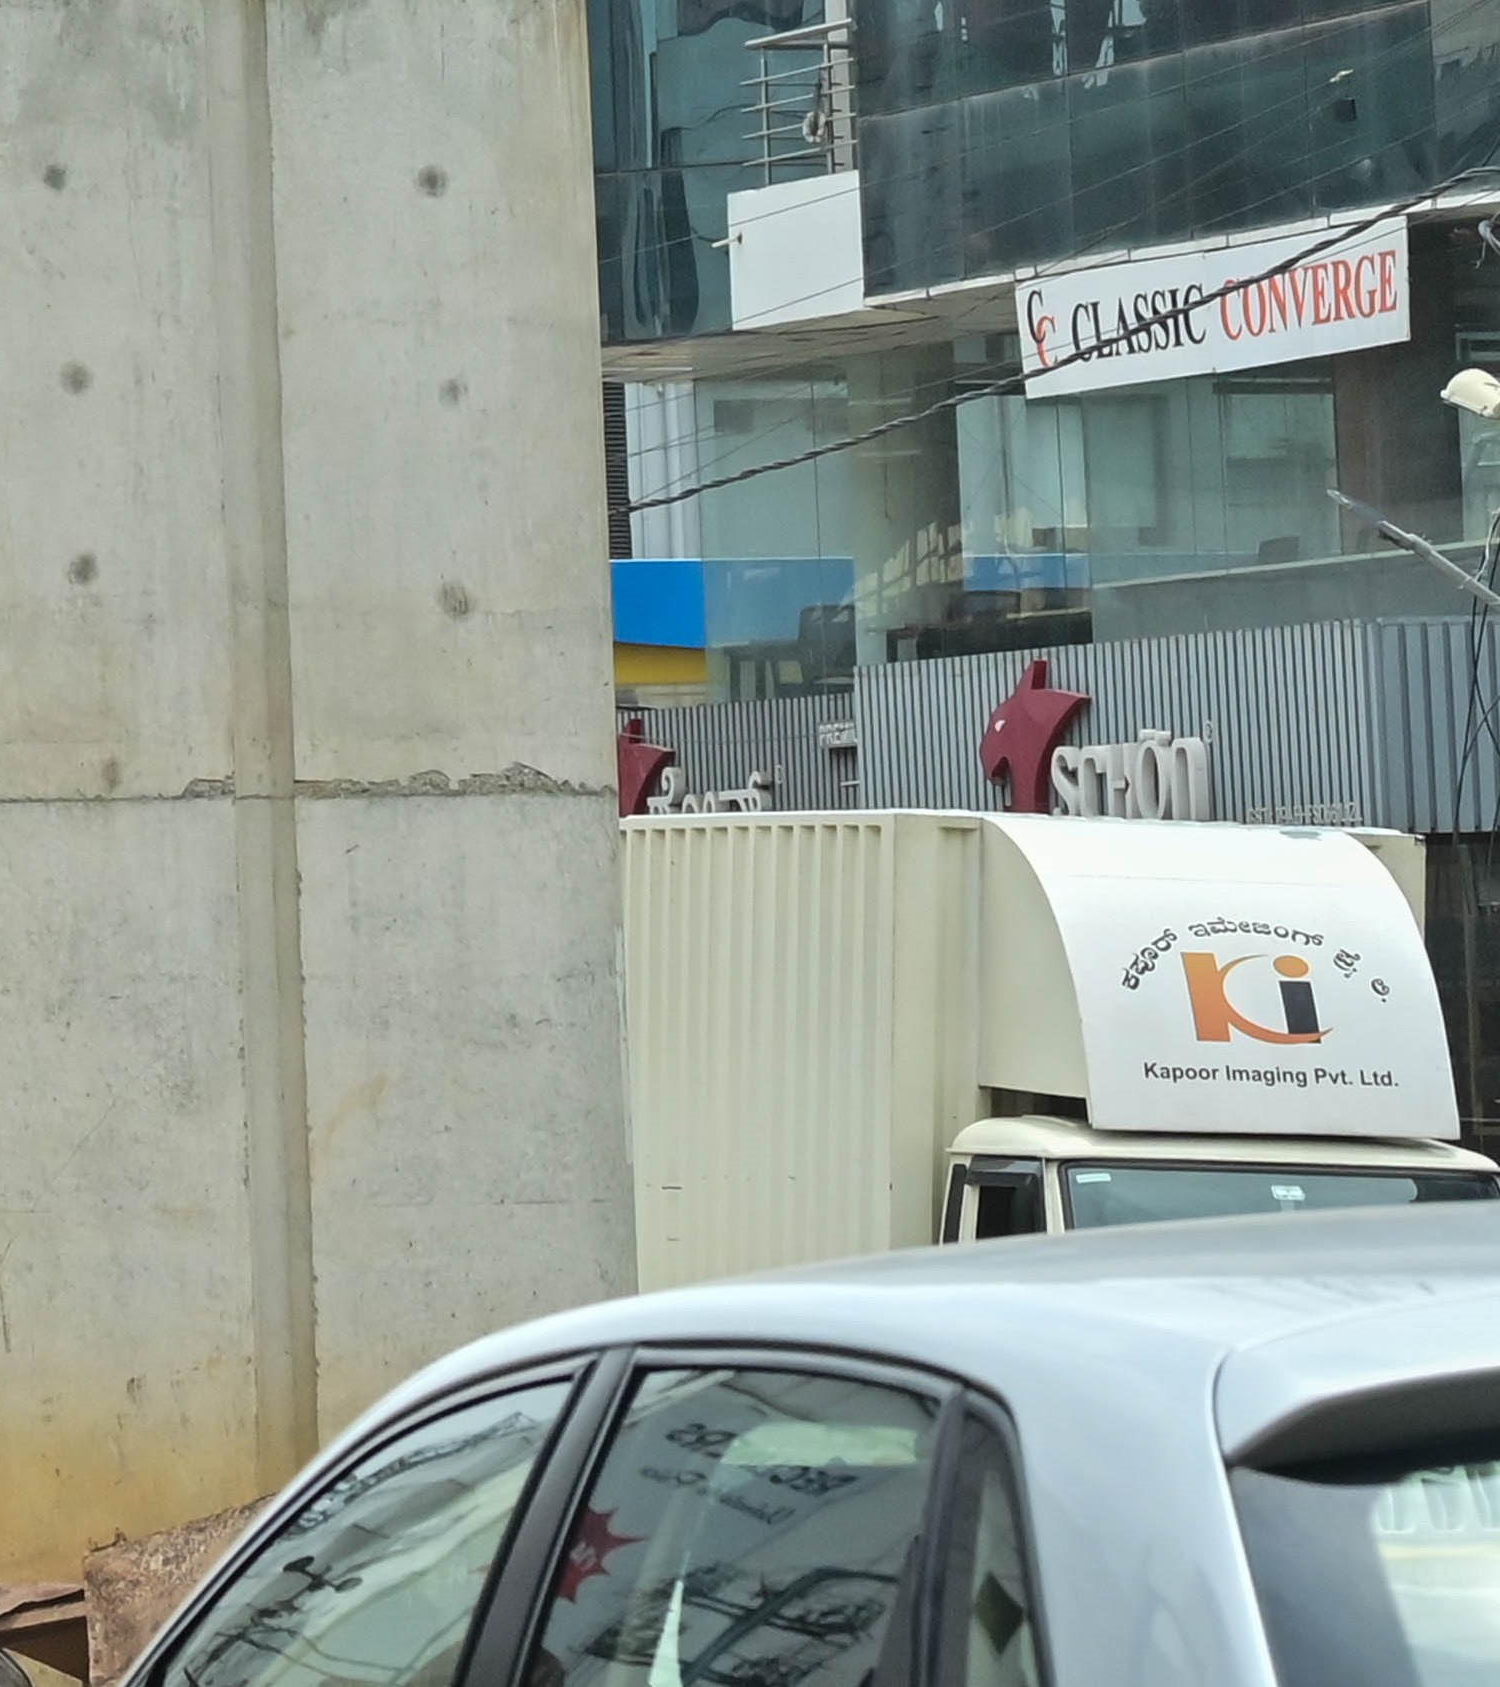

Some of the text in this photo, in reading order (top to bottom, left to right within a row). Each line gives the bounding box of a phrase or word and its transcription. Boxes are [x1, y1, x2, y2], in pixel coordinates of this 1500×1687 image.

[1071, 284, 1206, 362] CLASSIC
[1219, 250, 1397, 341] CONVERGE
[1143, 1062, 1400, 1088] Kapoor Imaging Pvt. Ltd.
